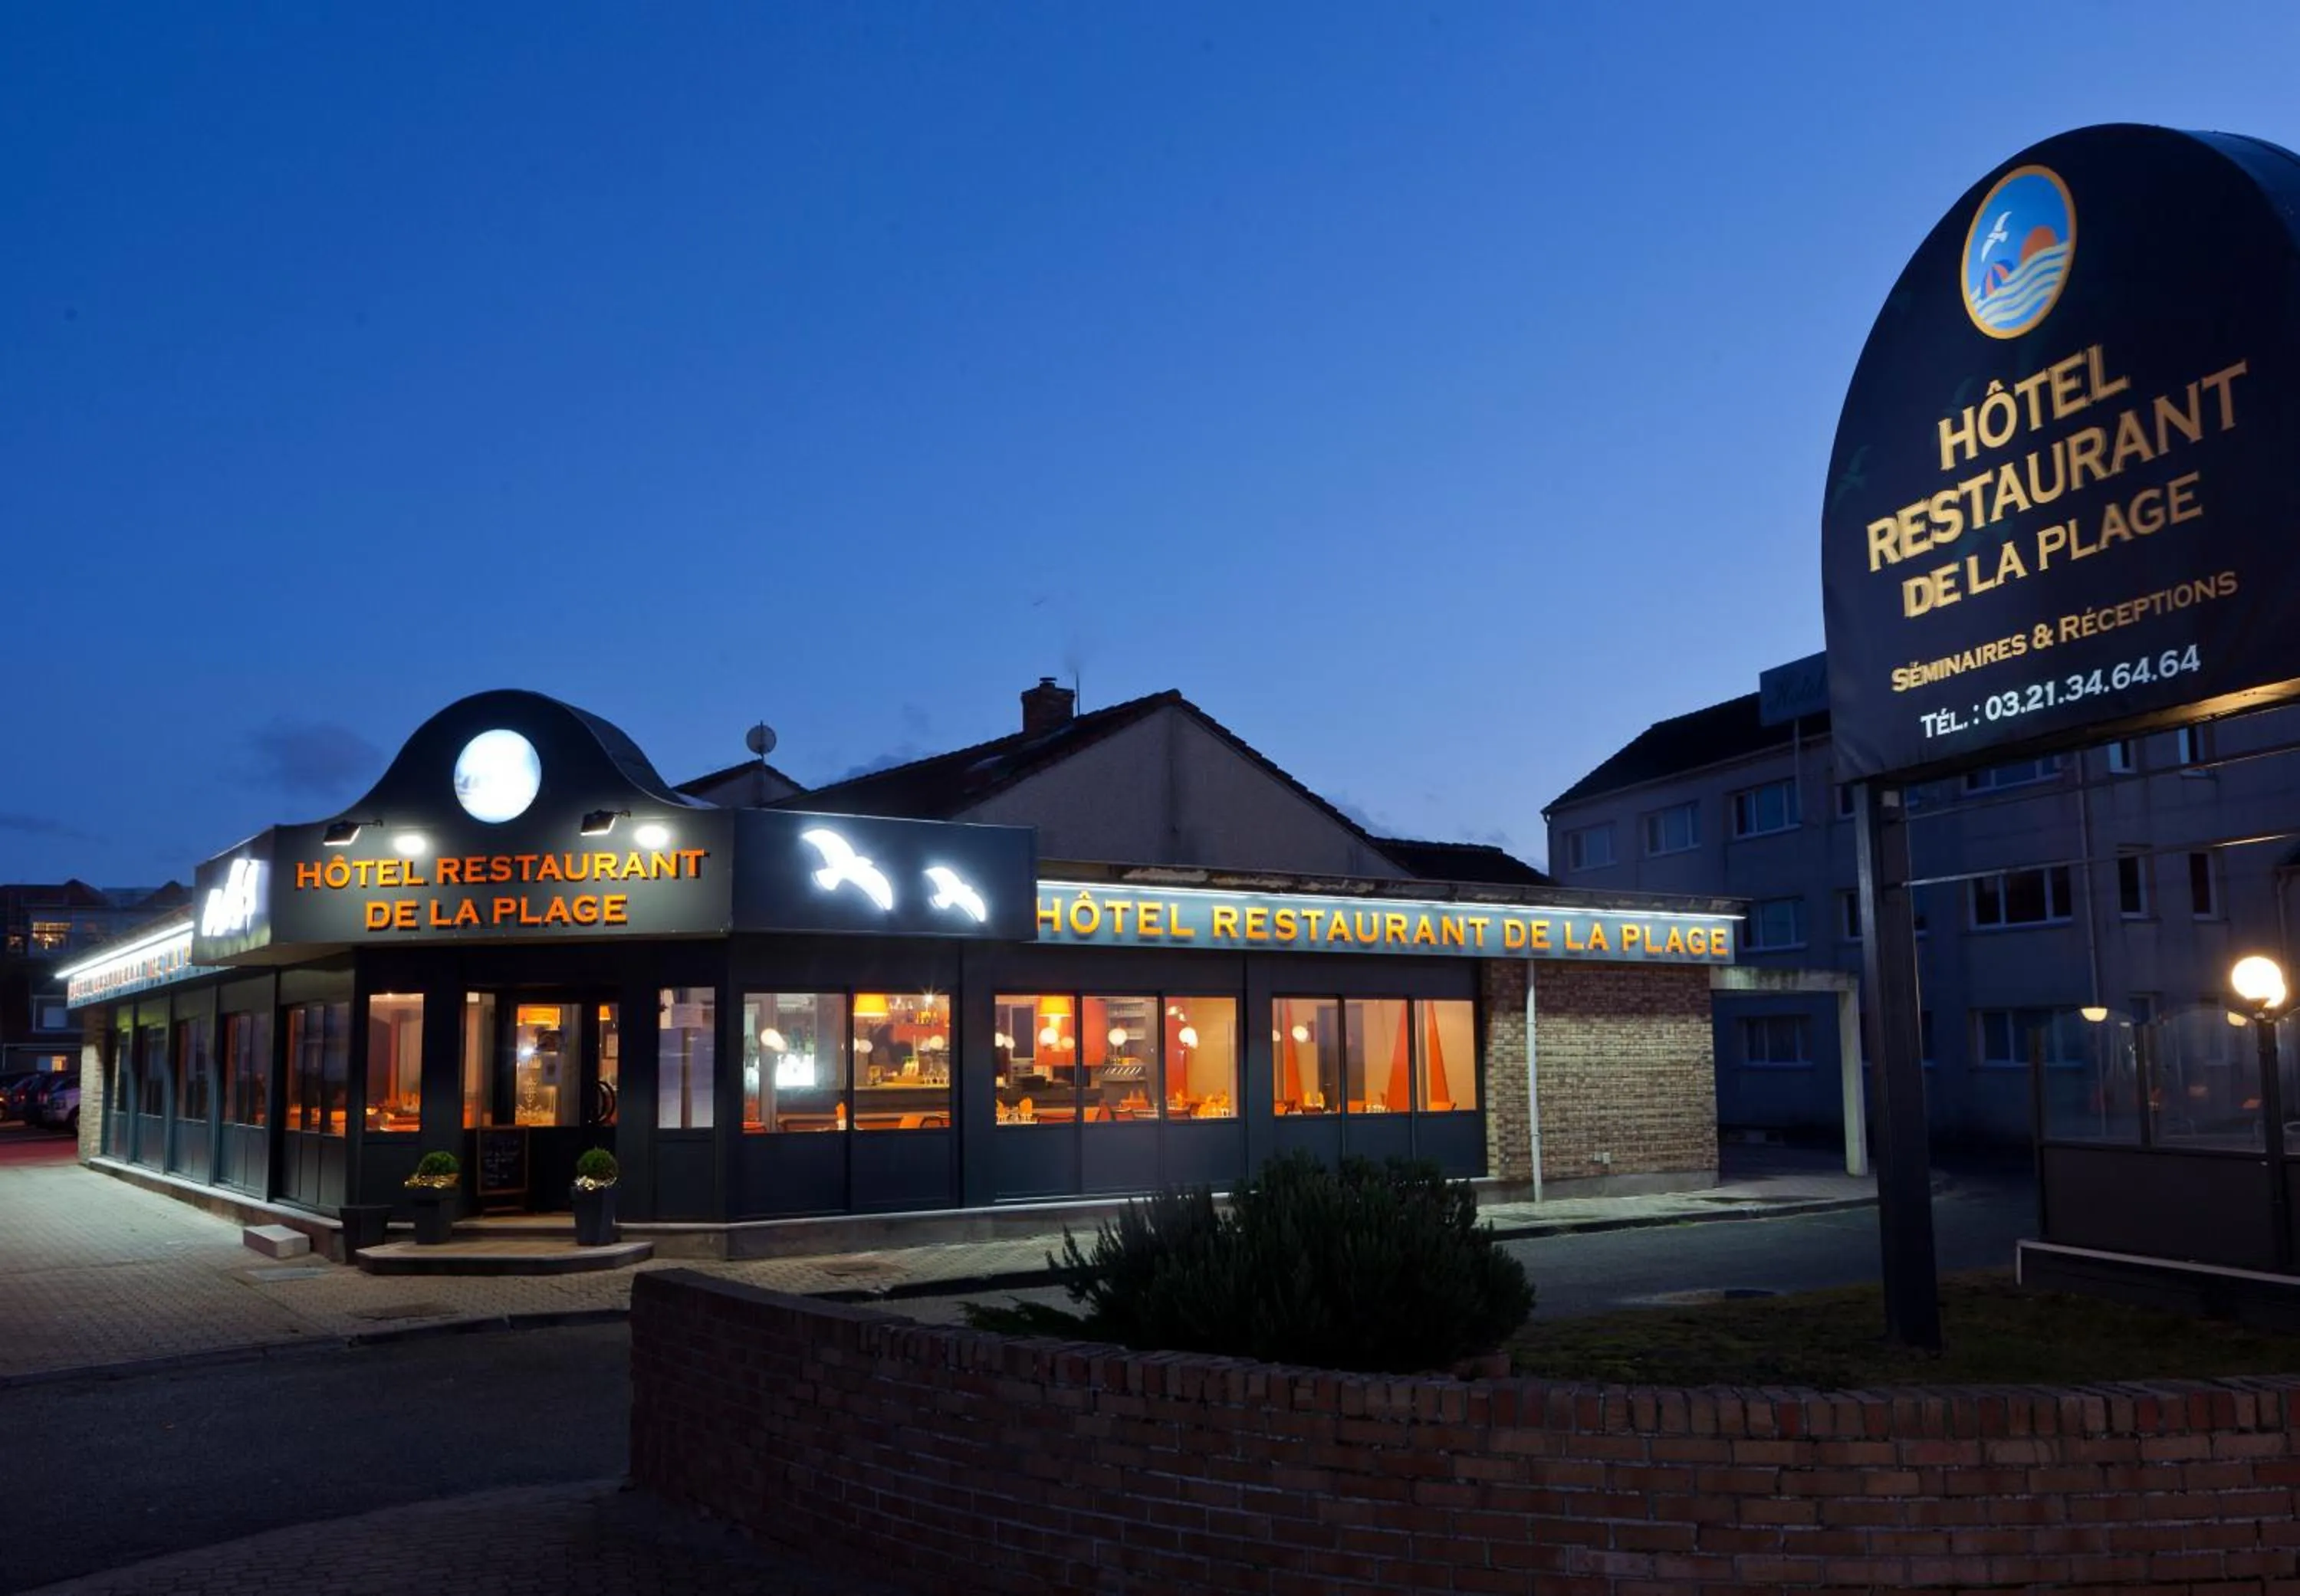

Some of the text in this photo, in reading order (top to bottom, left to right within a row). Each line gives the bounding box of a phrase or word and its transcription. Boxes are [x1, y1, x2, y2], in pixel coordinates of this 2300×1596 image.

[1937, 343, 2131, 470] HÔTEL
[1866, 359, 2248, 572] RESTAURANT
[1902, 471, 2203, 618] DE LA PLAGE
[1891, 570, 2239, 692] SÉMINAIRES & RÉCEPTIONS
[1985, 644, 2201, 721] 03.21.34.64.64
[295, 849, 708, 888] HÔTEL RESTAURANT
[365, 894, 627, 931] DE LA PLAGE
[1037, 890, 1728, 956] HÔTEL RESTAURANT DE LA PLAGE
